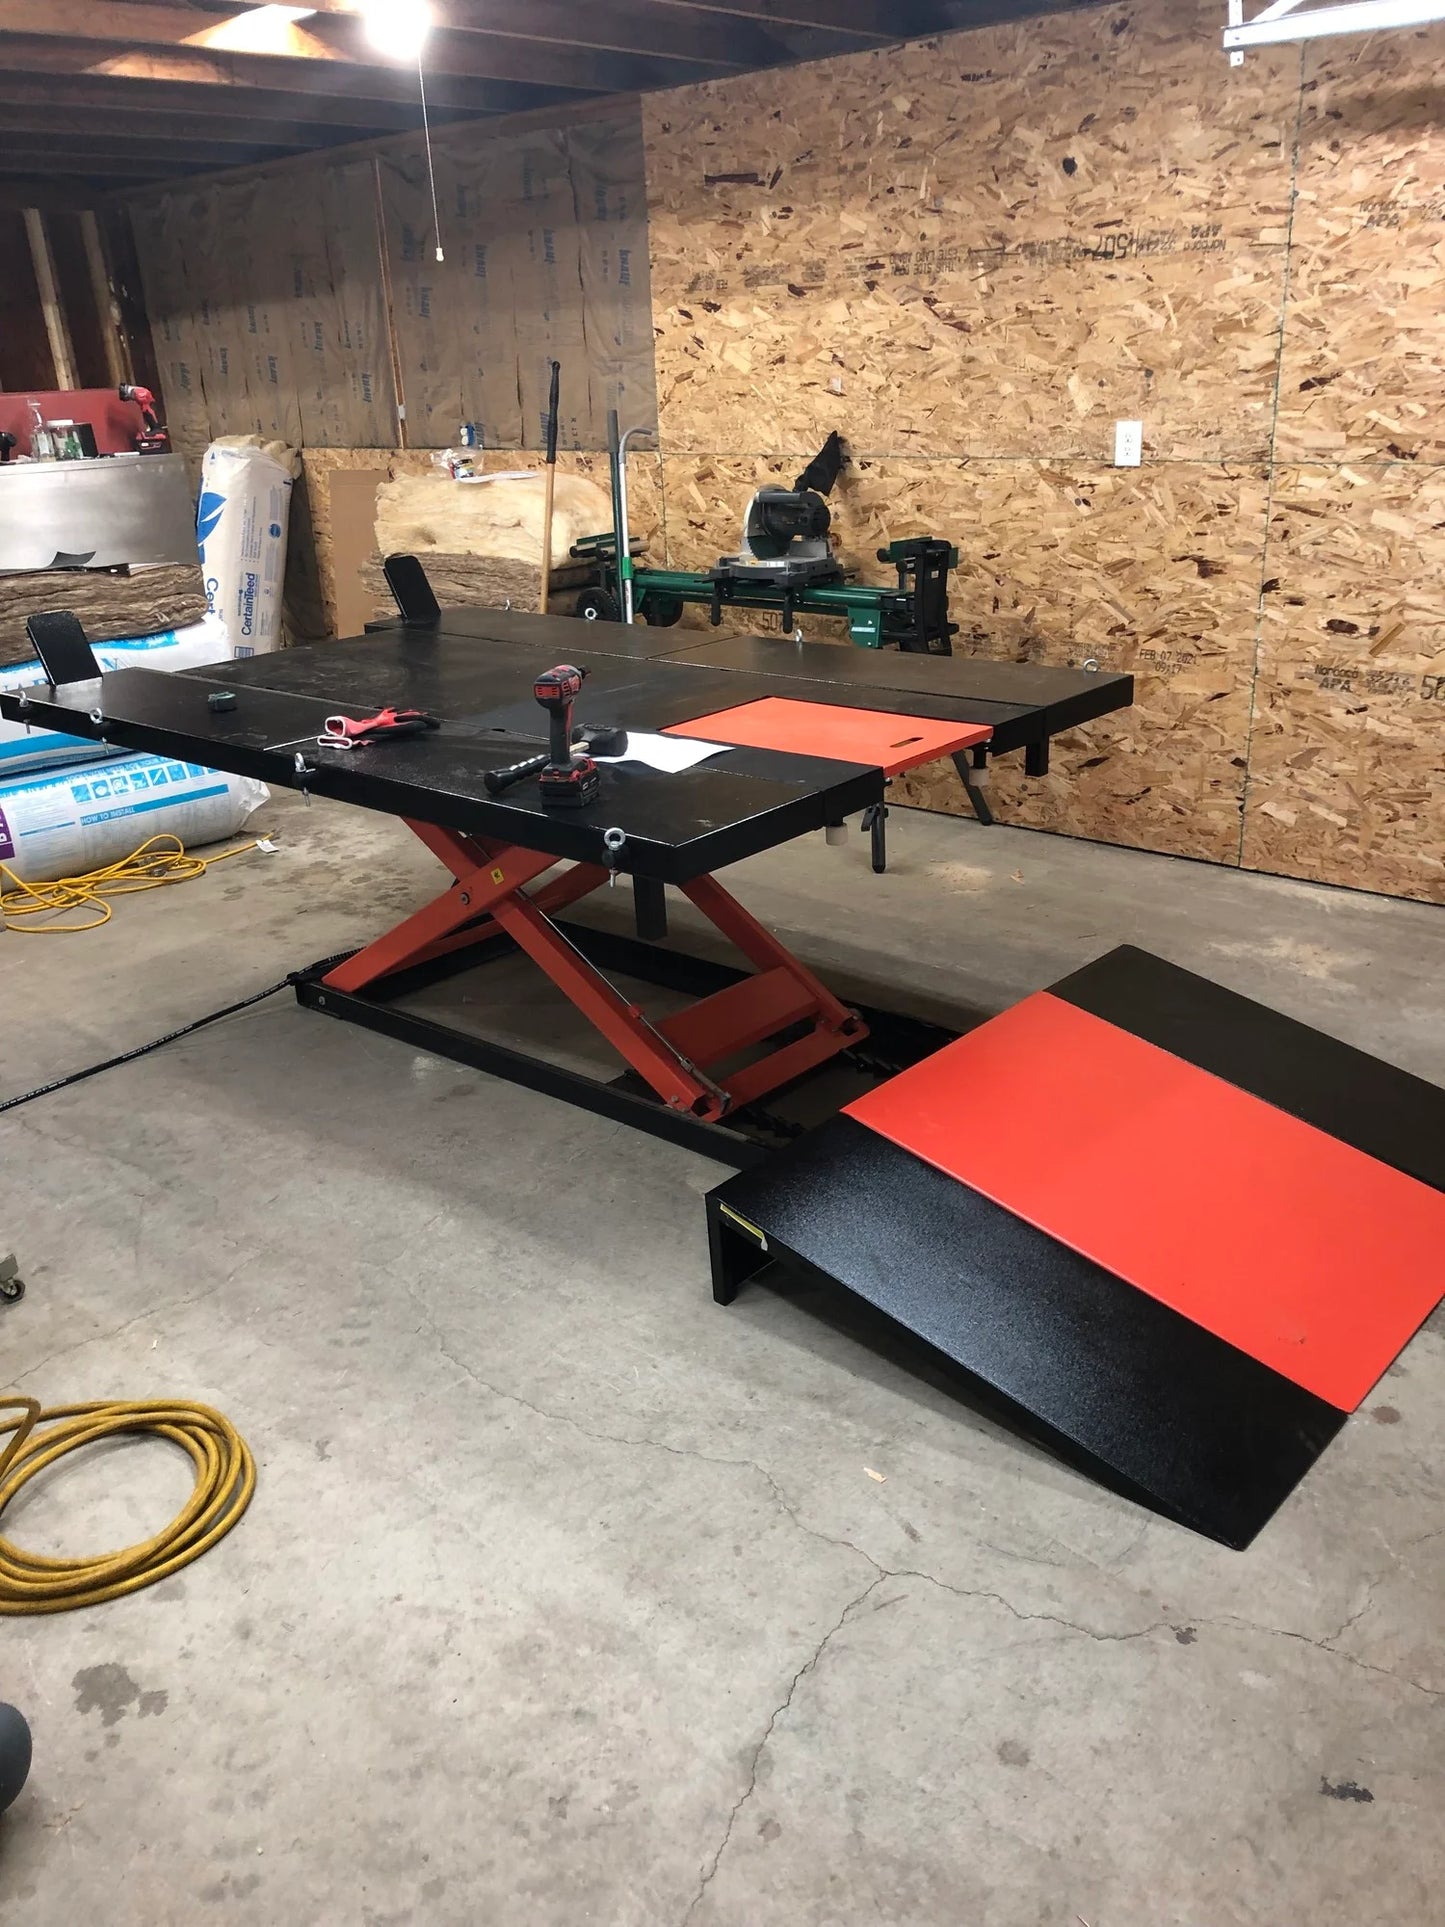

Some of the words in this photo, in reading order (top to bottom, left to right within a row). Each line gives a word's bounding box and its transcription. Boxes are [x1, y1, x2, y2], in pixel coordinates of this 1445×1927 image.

[241, 572, 256, 636] CertainTeed
[1140, 648, 1157, 661] FEB
[1160, 651, 1173, 661] 07
[80, 815, 98, 825] HOW
[100, 812, 110, 820] TO
[110, 807, 136, 819] INSTALL
